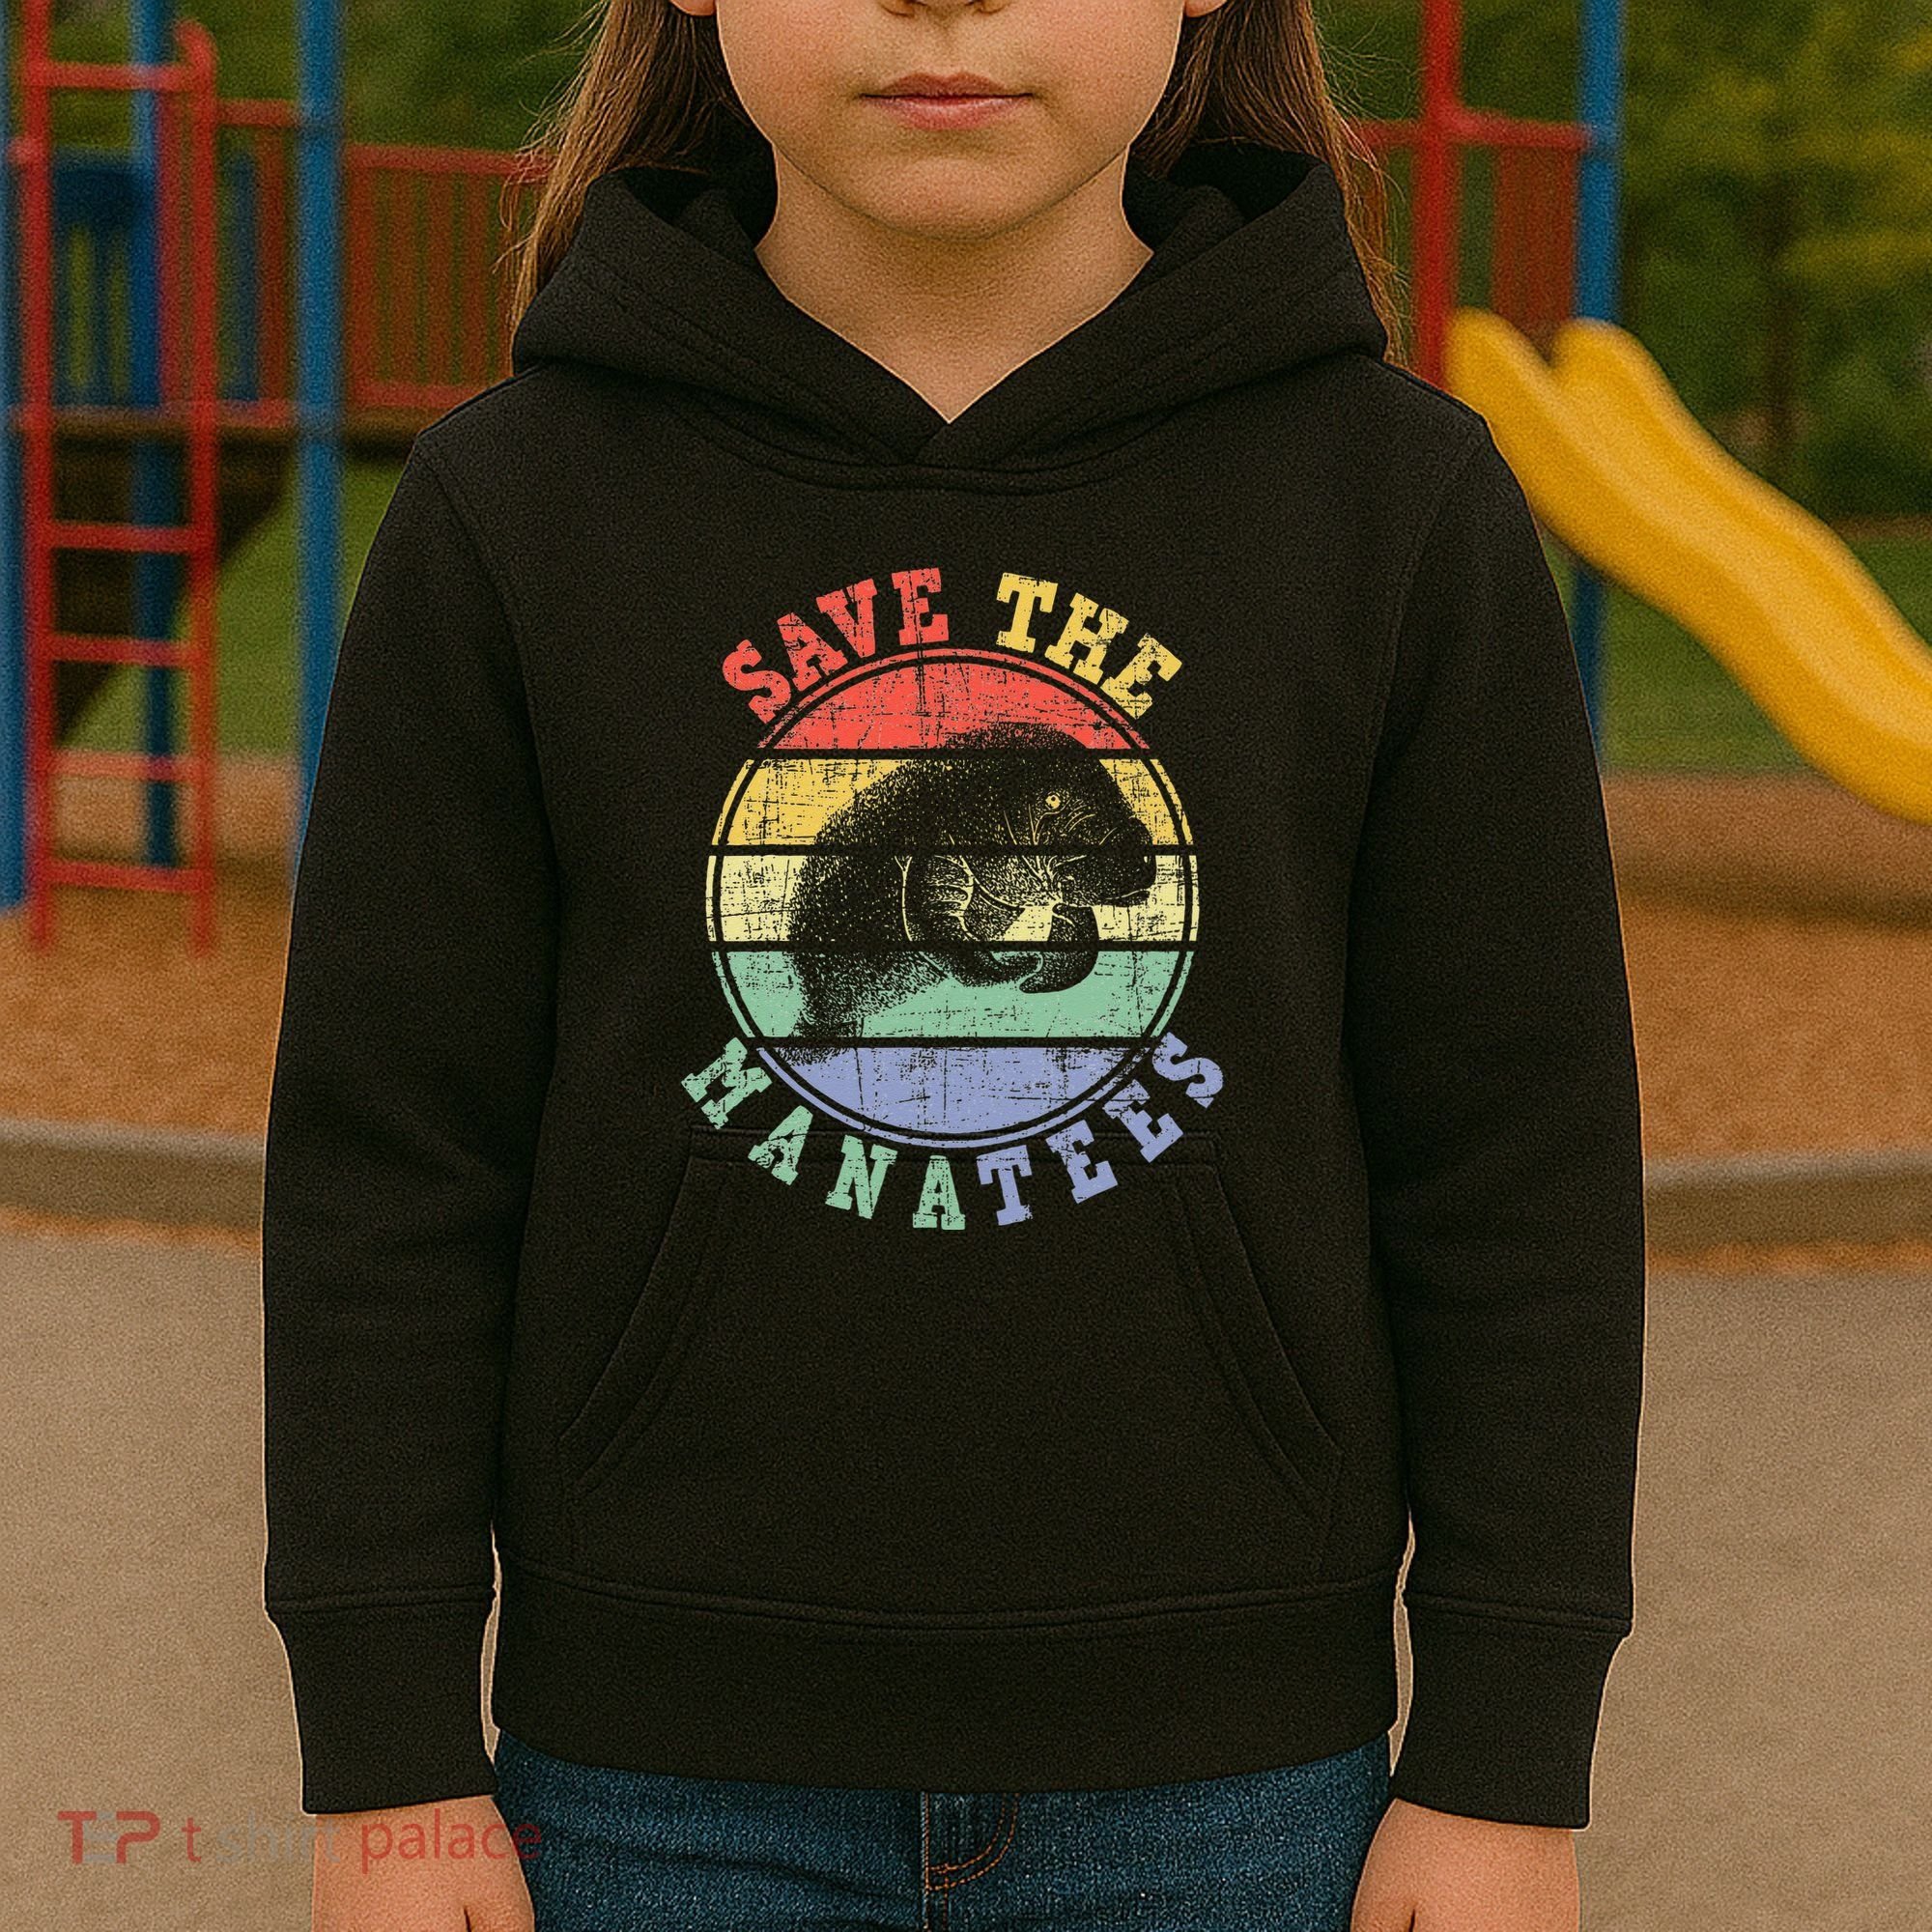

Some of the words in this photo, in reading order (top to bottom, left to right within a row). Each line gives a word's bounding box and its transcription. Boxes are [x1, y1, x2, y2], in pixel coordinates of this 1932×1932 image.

[723, 567, 950, 724] SAVE
[996, 572, 1183, 719] THE
[681, 1032, 1224, 1231] MANATEES
